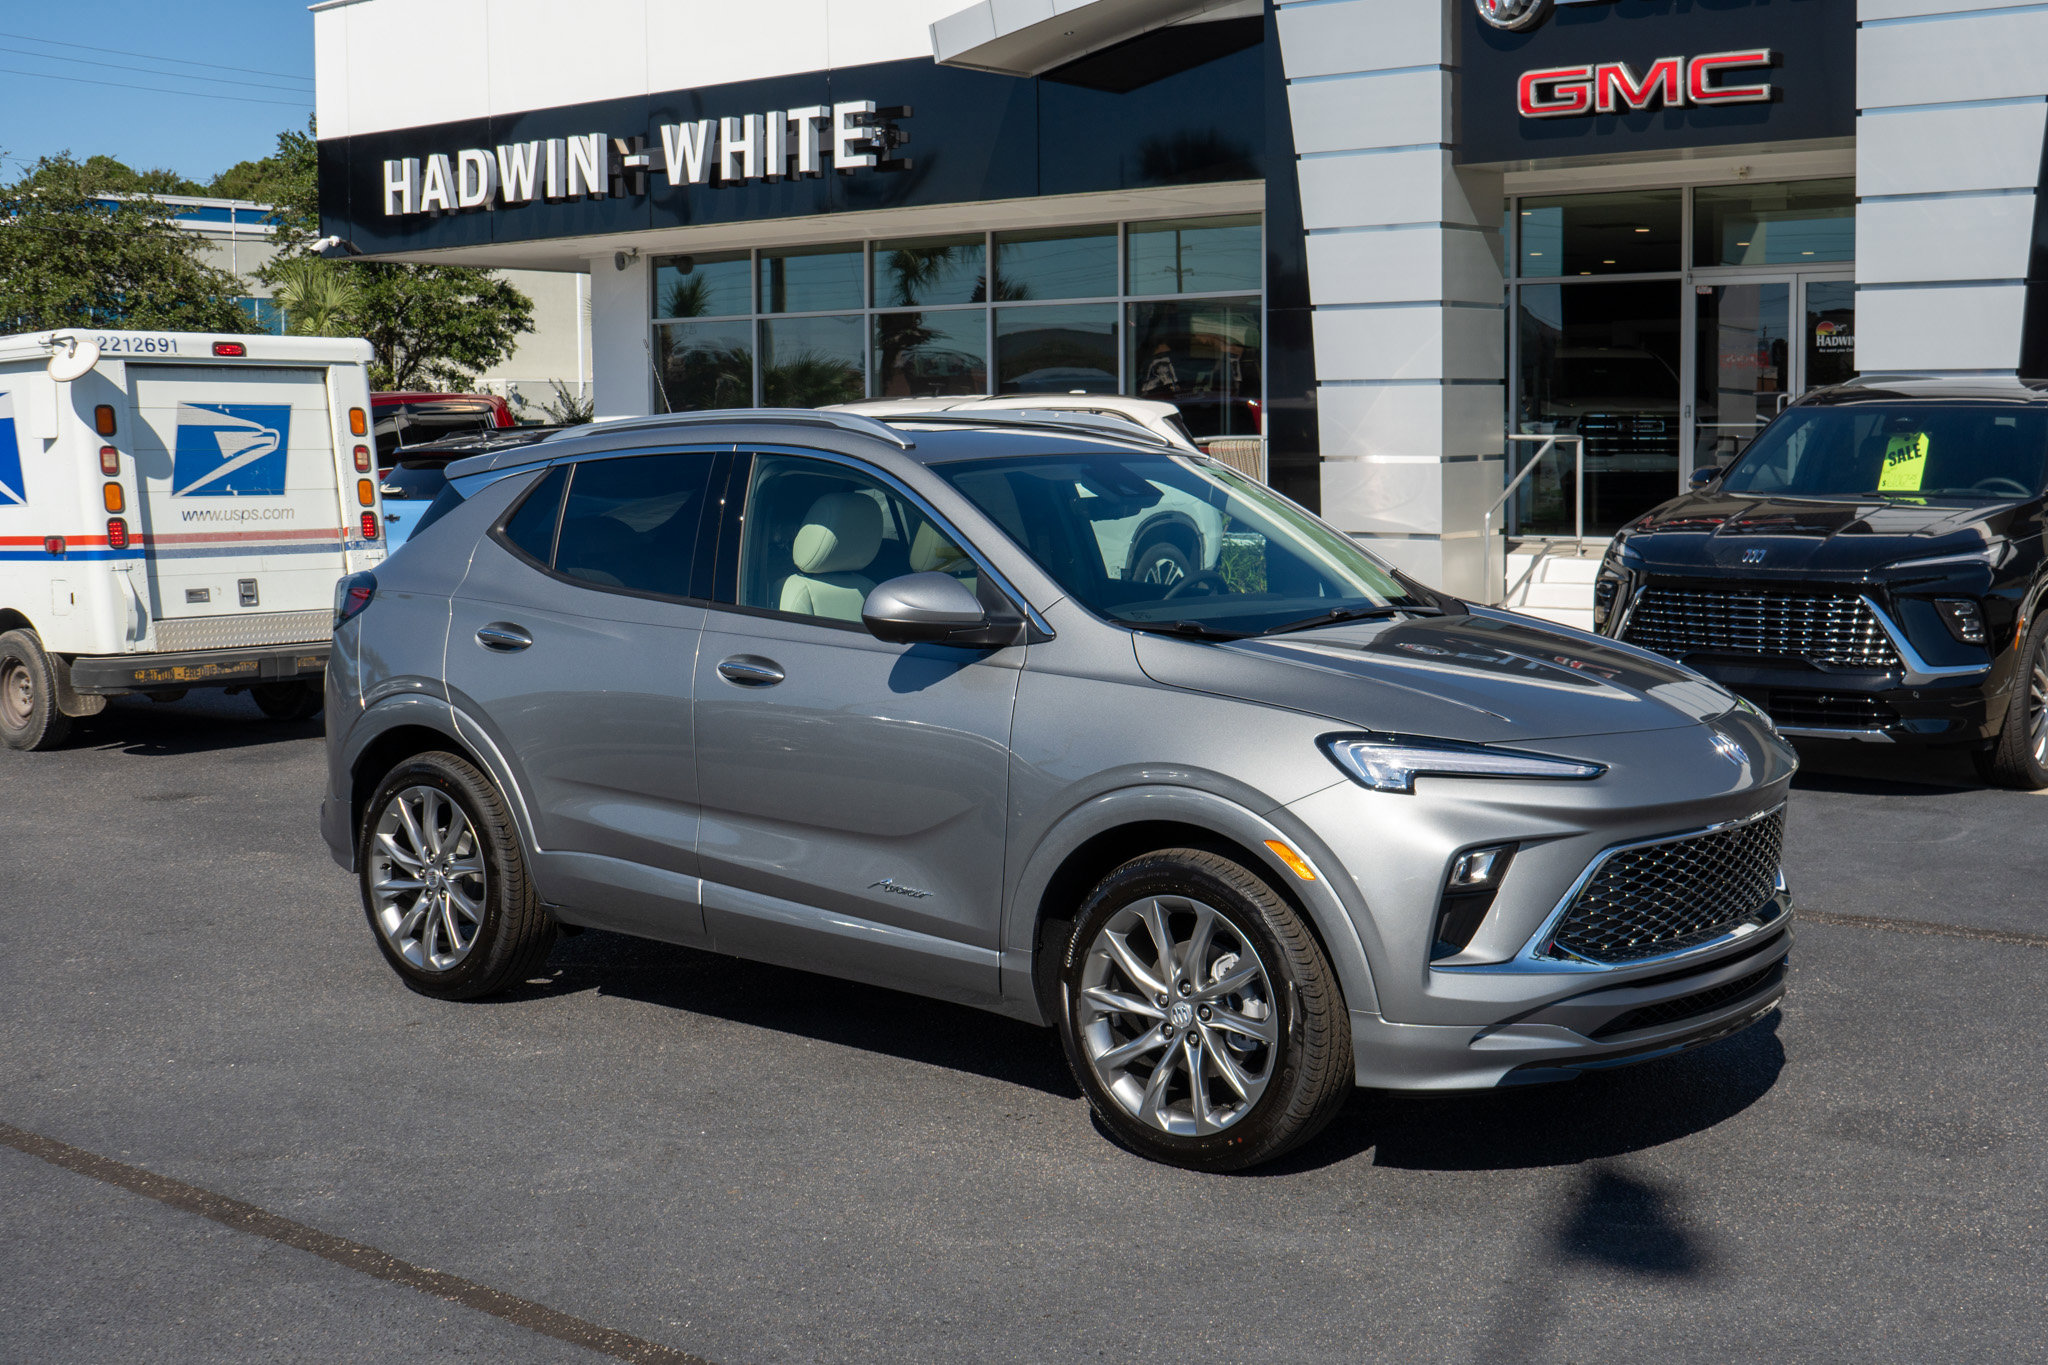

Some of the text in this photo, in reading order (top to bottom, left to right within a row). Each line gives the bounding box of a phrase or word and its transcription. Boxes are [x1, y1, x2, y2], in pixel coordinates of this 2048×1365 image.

[1517, 48, 1771, 118] GMC
[97, 336, 178, 353] 2212691
[1888, 442, 1922, 467] SALE
[181, 508, 295, 524] www.usps.com
